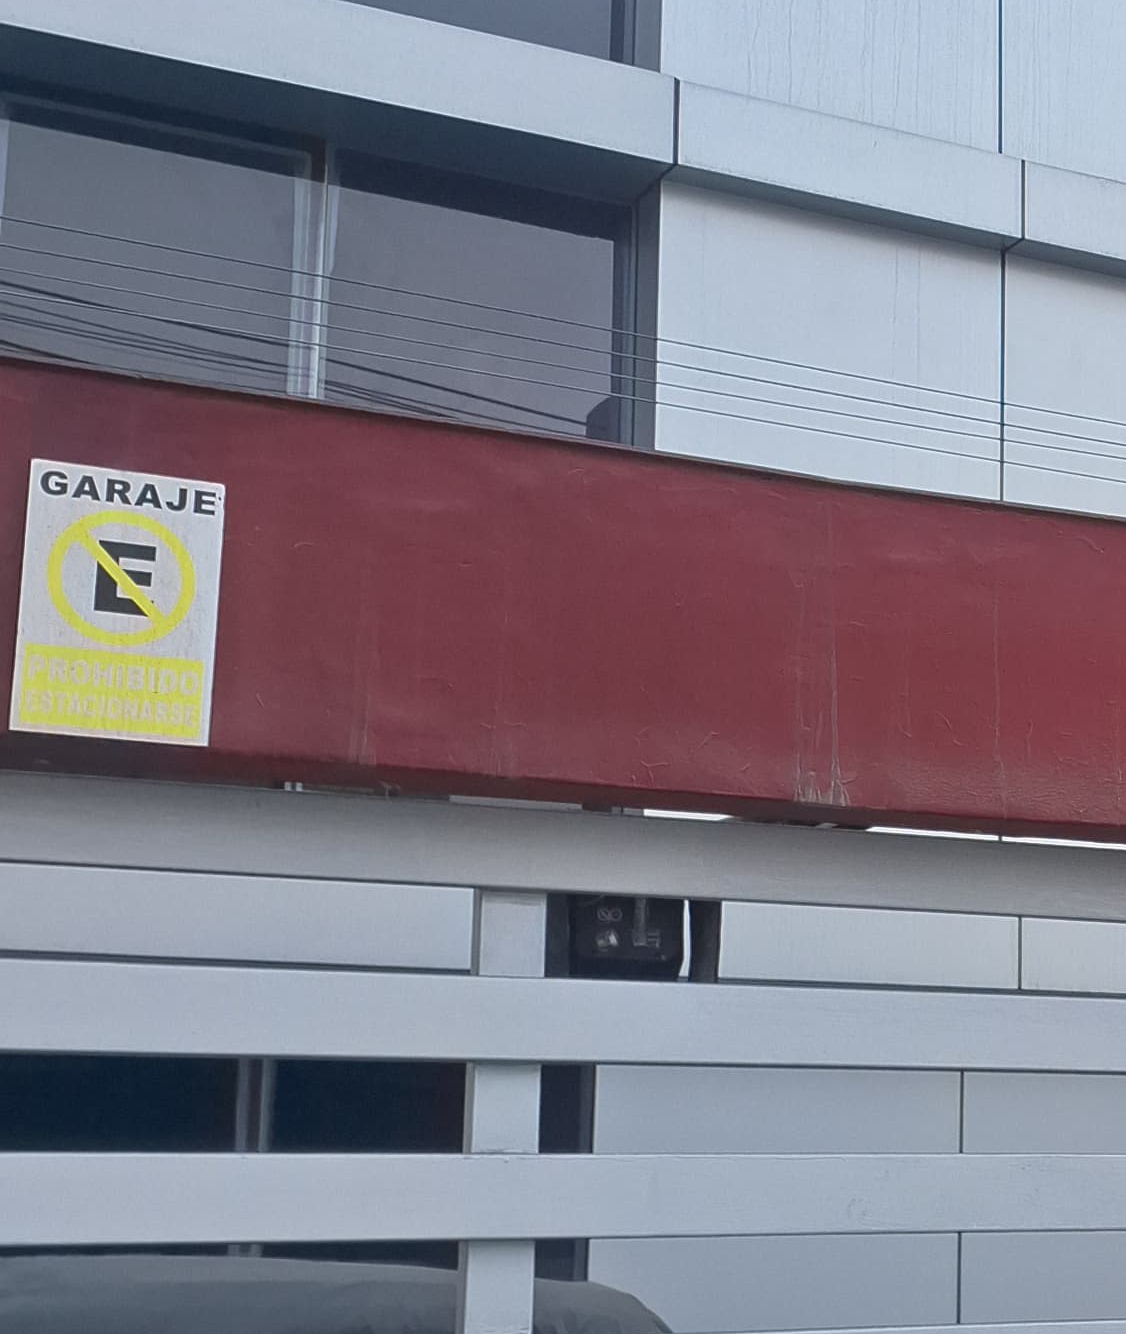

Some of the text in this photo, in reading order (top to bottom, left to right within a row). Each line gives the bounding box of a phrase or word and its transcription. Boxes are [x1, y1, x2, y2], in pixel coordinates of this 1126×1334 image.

[40, 470, 217, 516] GARAJE
[93, 539, 157, 617] E
[28, 654, 199, 695] PROHIBIDO
[25, 689, 198, 727] ESTACIONARSE
